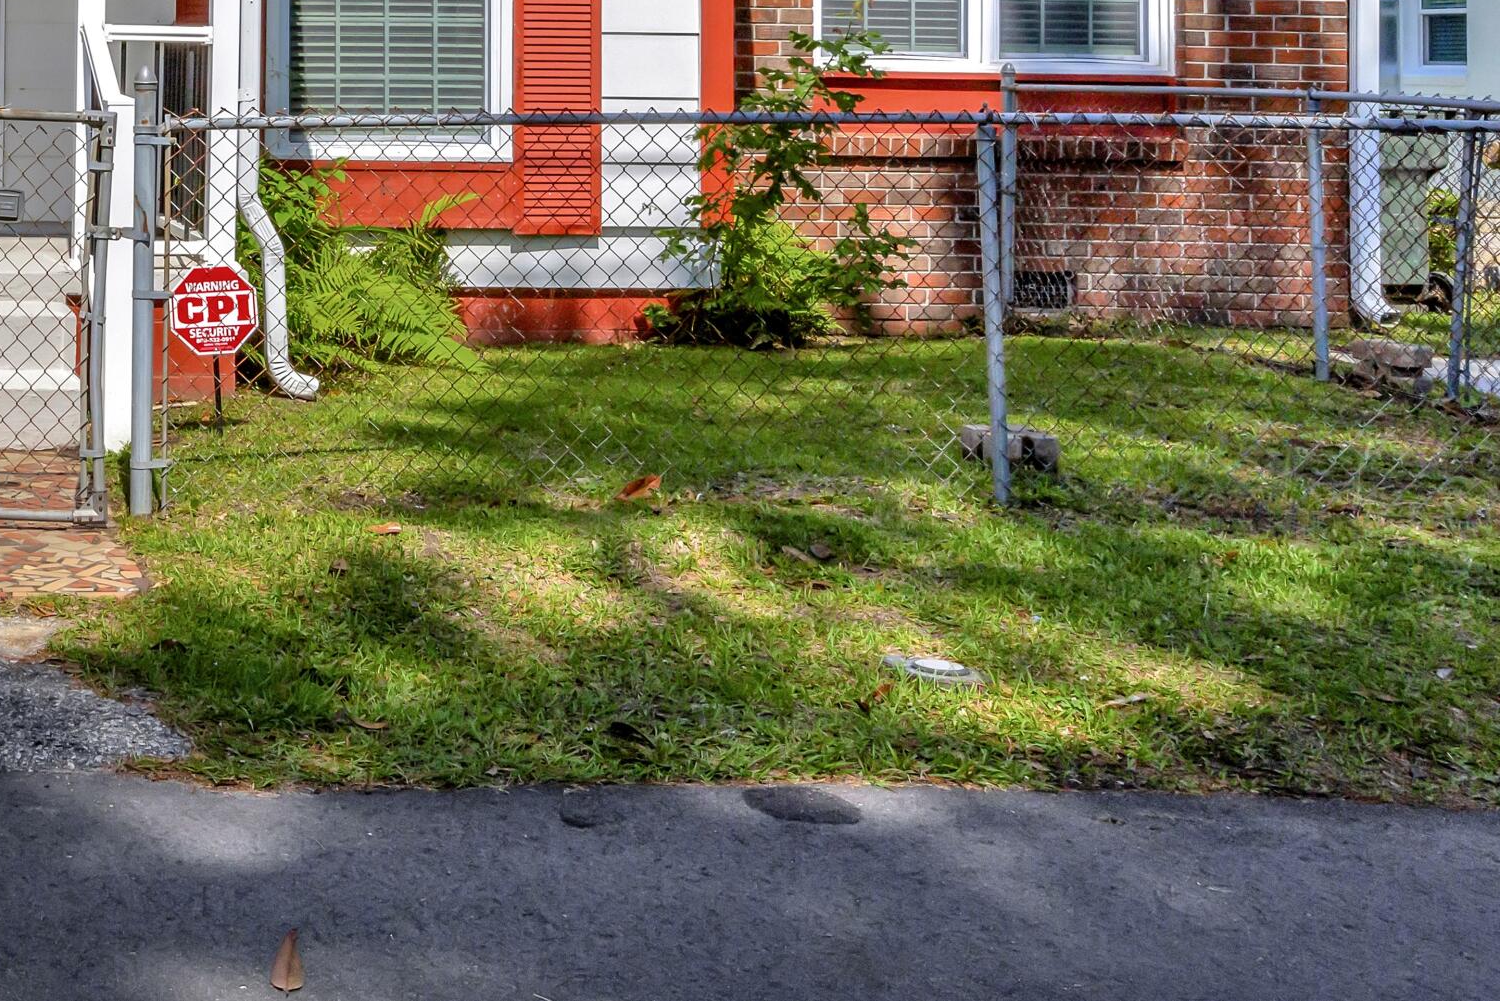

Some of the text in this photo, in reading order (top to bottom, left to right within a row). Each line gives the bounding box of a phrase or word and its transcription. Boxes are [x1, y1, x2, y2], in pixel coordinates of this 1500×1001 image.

[185, 280, 240, 293] WARNING
[177, 294, 251, 325] CPI
[189, 326, 240, 339] SECURITY
